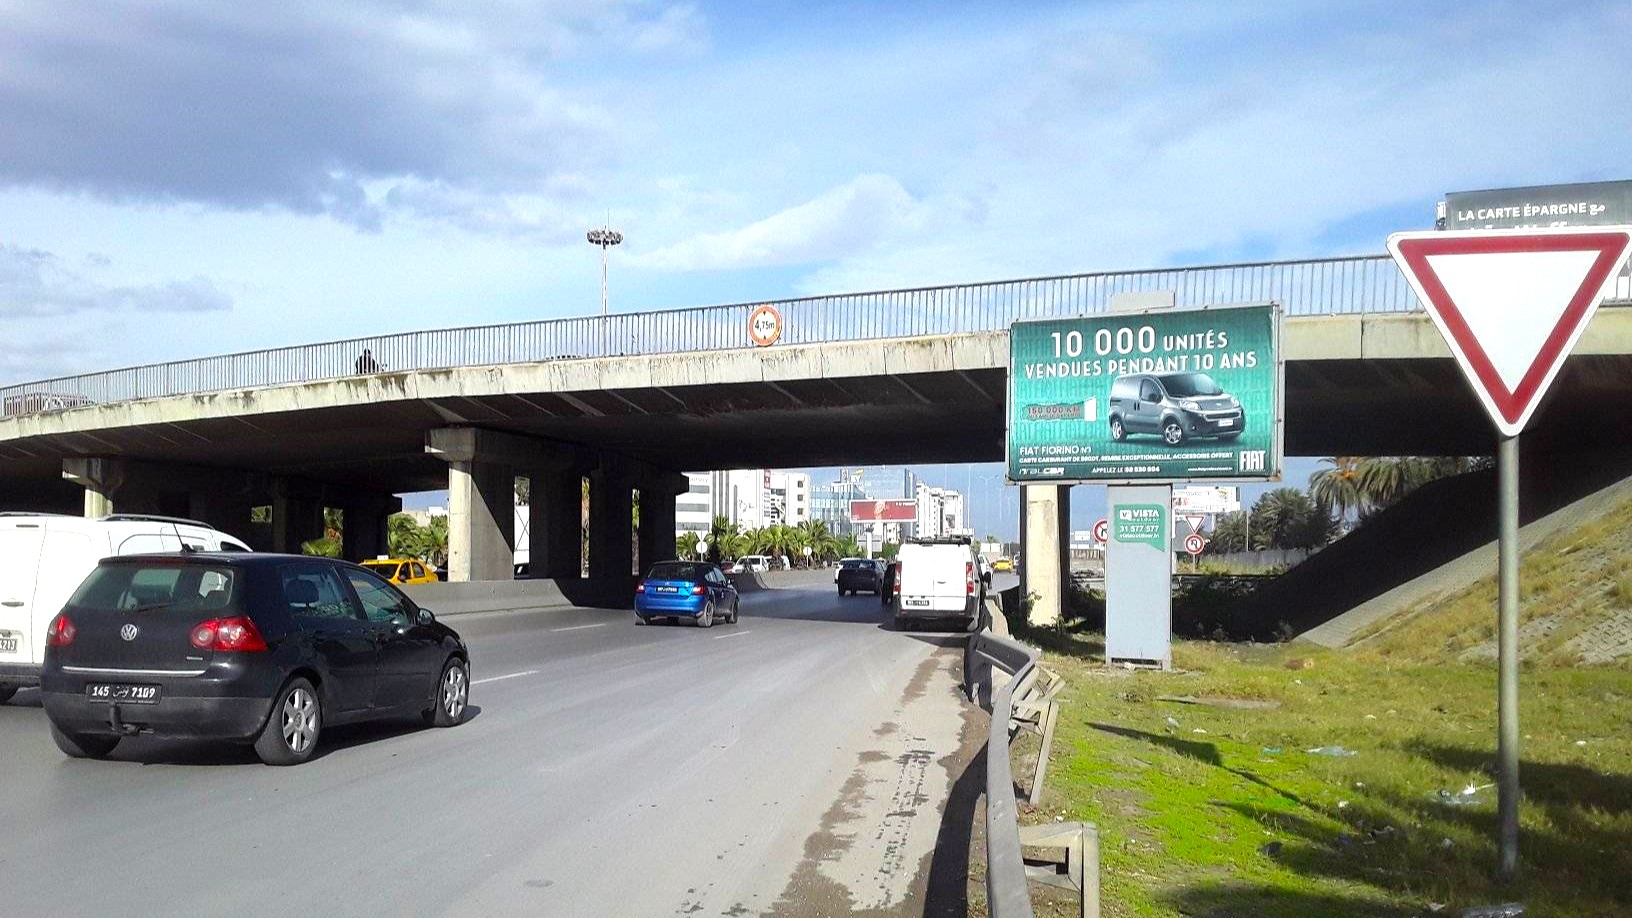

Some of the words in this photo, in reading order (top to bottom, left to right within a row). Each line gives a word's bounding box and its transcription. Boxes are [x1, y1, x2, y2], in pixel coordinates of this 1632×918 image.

[1458, 211, 1475, 221] LA
[1478, 206, 1520, 220] CARTE
[1523, 202, 1587, 217] ÉPARGNE
[755, 320, 775, 332] 4,75m
[1051, 331, 1083, 358] 10
[1095, 326, 1156, 355] 000
[1163, 329, 1228, 351] UNITÉS
[1025, 360, 1102, 379] VENDUES
[1107, 355, 1189, 376] PENDANT
[1194, 353, 1214, 370] 10
[1220, 351, 1257, 369] ANS
[1020, 446, 1039, 455] FIAT
[1041, 445, 1080, 455] FIORINO
[1210, 451, 1233, 459] OFFERT
[1240, 450, 1266, 470] FIAT
[1132, 509, 1160, 518] VISTA
[92, 685, 110, 697] 145
[131, 686, 156, 699] 7109
